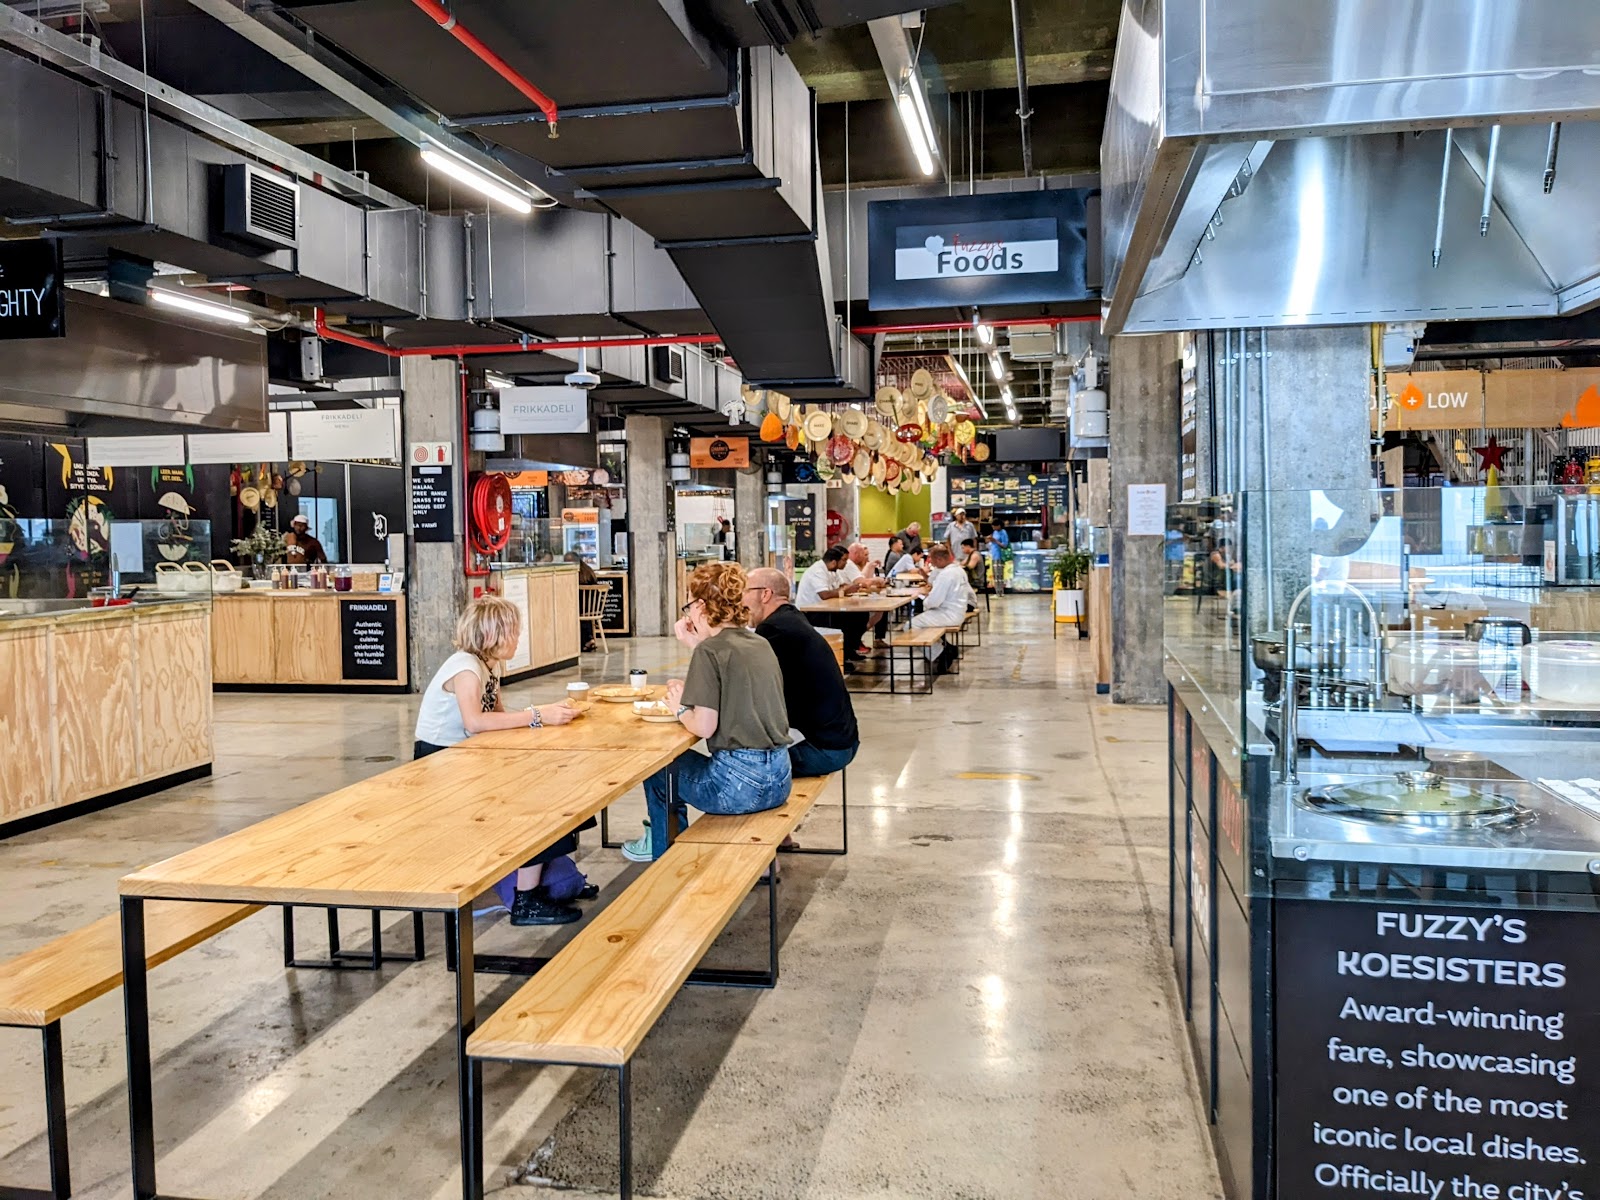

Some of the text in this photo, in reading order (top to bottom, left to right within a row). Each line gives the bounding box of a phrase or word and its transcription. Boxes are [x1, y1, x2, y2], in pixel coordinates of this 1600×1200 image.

[937, 247, 1023, 273] Foods
[513, 404, 574, 414] FRIKKADELI
[1427, 392, 1468, 409] LOW
[353, 628, 385, 636] Cape Malay
[1376, 911, 1528, 944] FUZZY'S
[1337, 950, 1567, 988] KOESISTERS
[1339, 996, 1564, 1041] Award-winning
[1327, 1036, 1577, 1085] fare, showcasing
[1332, 1085, 1568, 1121] one of the most
[1313, 1122, 1587, 1165] iconic local dishes.
[1314, 1163, 1584, 1200] Officially the city's
